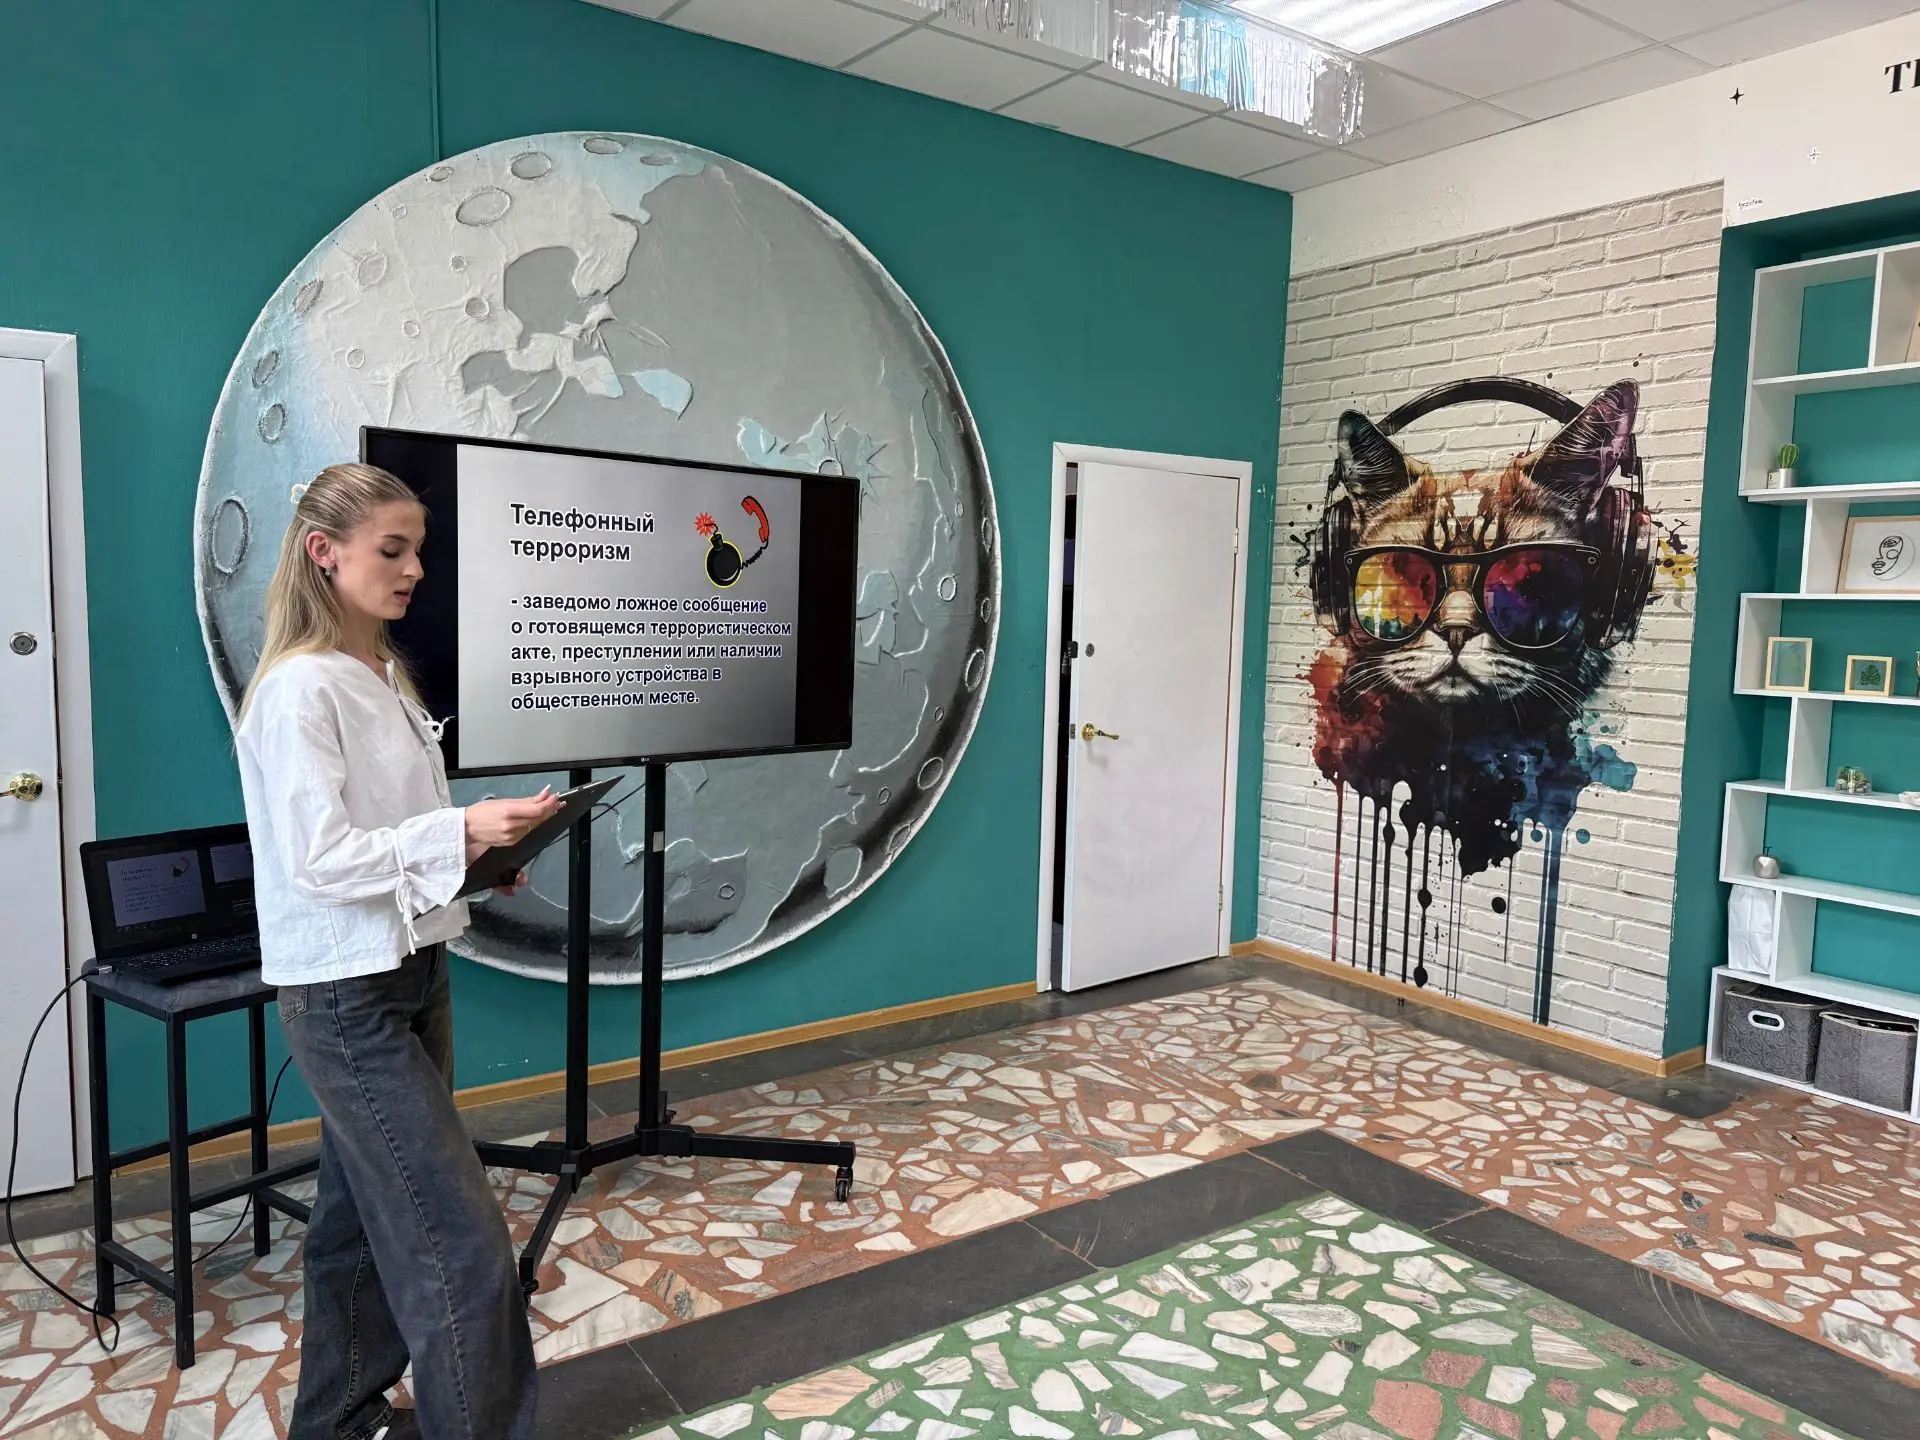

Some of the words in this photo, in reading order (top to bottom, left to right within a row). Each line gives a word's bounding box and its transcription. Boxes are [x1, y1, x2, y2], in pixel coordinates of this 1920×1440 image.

[510, 503, 655, 533] Телефонный
[510, 540, 631, 564] терроризм
[522, 596, 611, 612] заведомо
[615, 598, 678, 611] ложное
[682, 597, 768, 615] сообщение
[511, 622, 523, 634] о
[528, 622, 645, 637] готовящемся
[650, 622, 791, 638] террористическом
[511, 646, 556, 662] акте,
[562, 646, 682, 663] преступлении
[687, 646, 716, 658] или
[720, 645, 782, 658] наличии
[511, 670, 612, 689] взрывного
[616, 665, 708, 686] устройства
[712, 668, 722, 680] в
[511, 692, 644, 711] общественном
[649, 691, 700, 704] месте.
